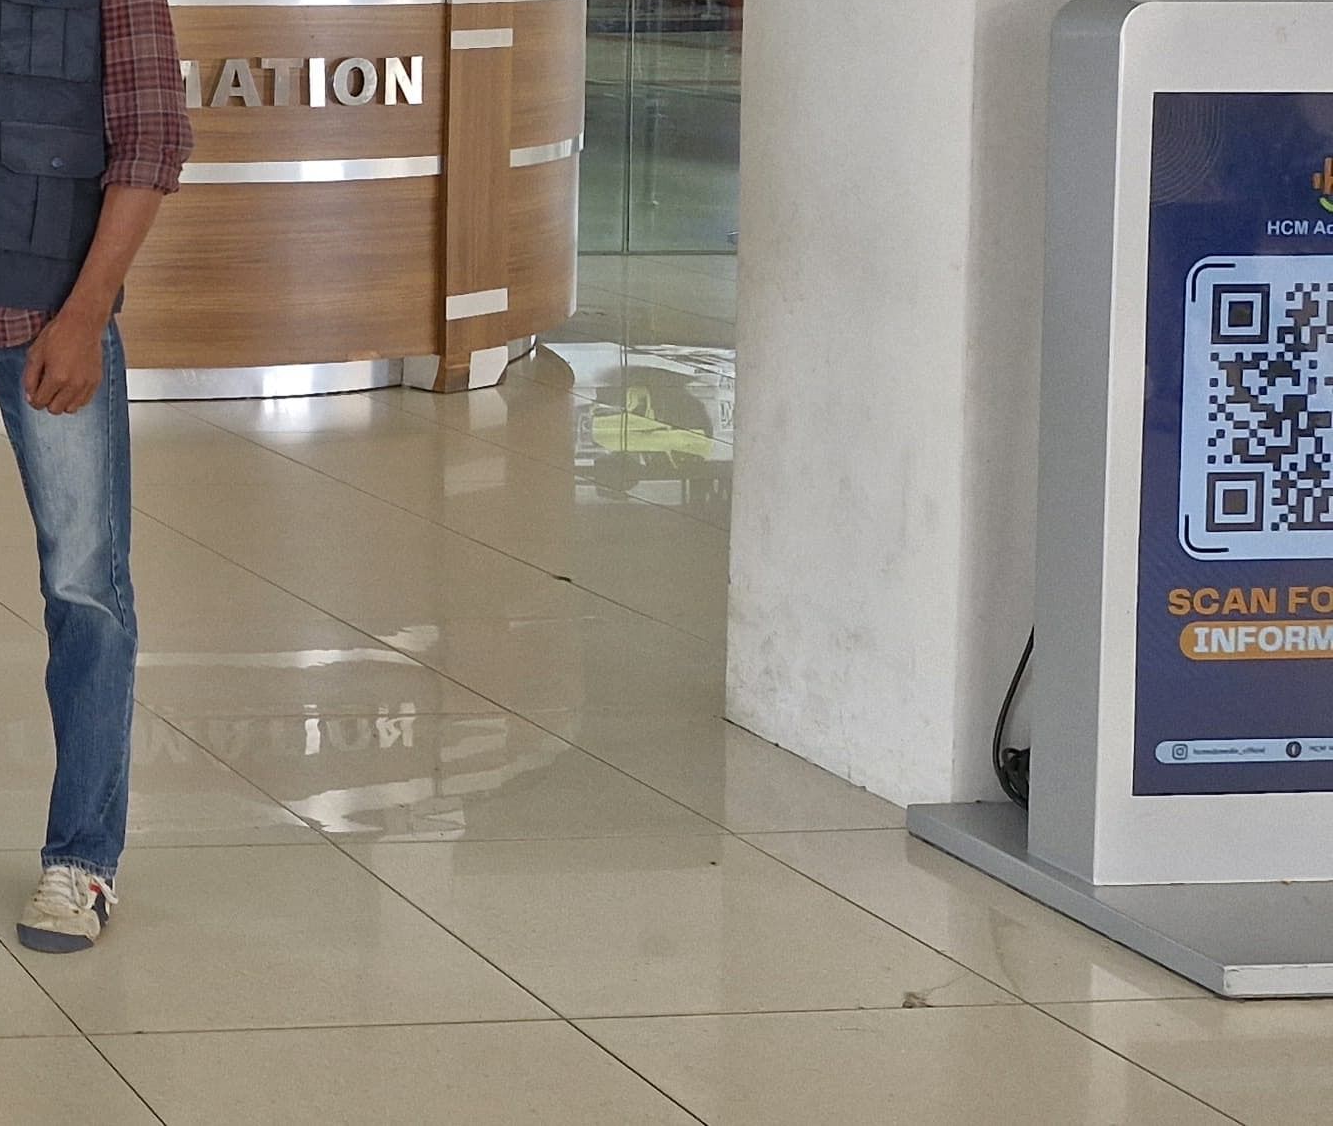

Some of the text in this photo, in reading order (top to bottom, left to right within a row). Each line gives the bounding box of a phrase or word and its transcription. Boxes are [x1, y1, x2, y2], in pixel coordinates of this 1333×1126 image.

[1267, 220, 1309, 235] HCM
[1168, 587, 1278, 615] SCAN
[1193, 626, 1333, 653] INFORM
